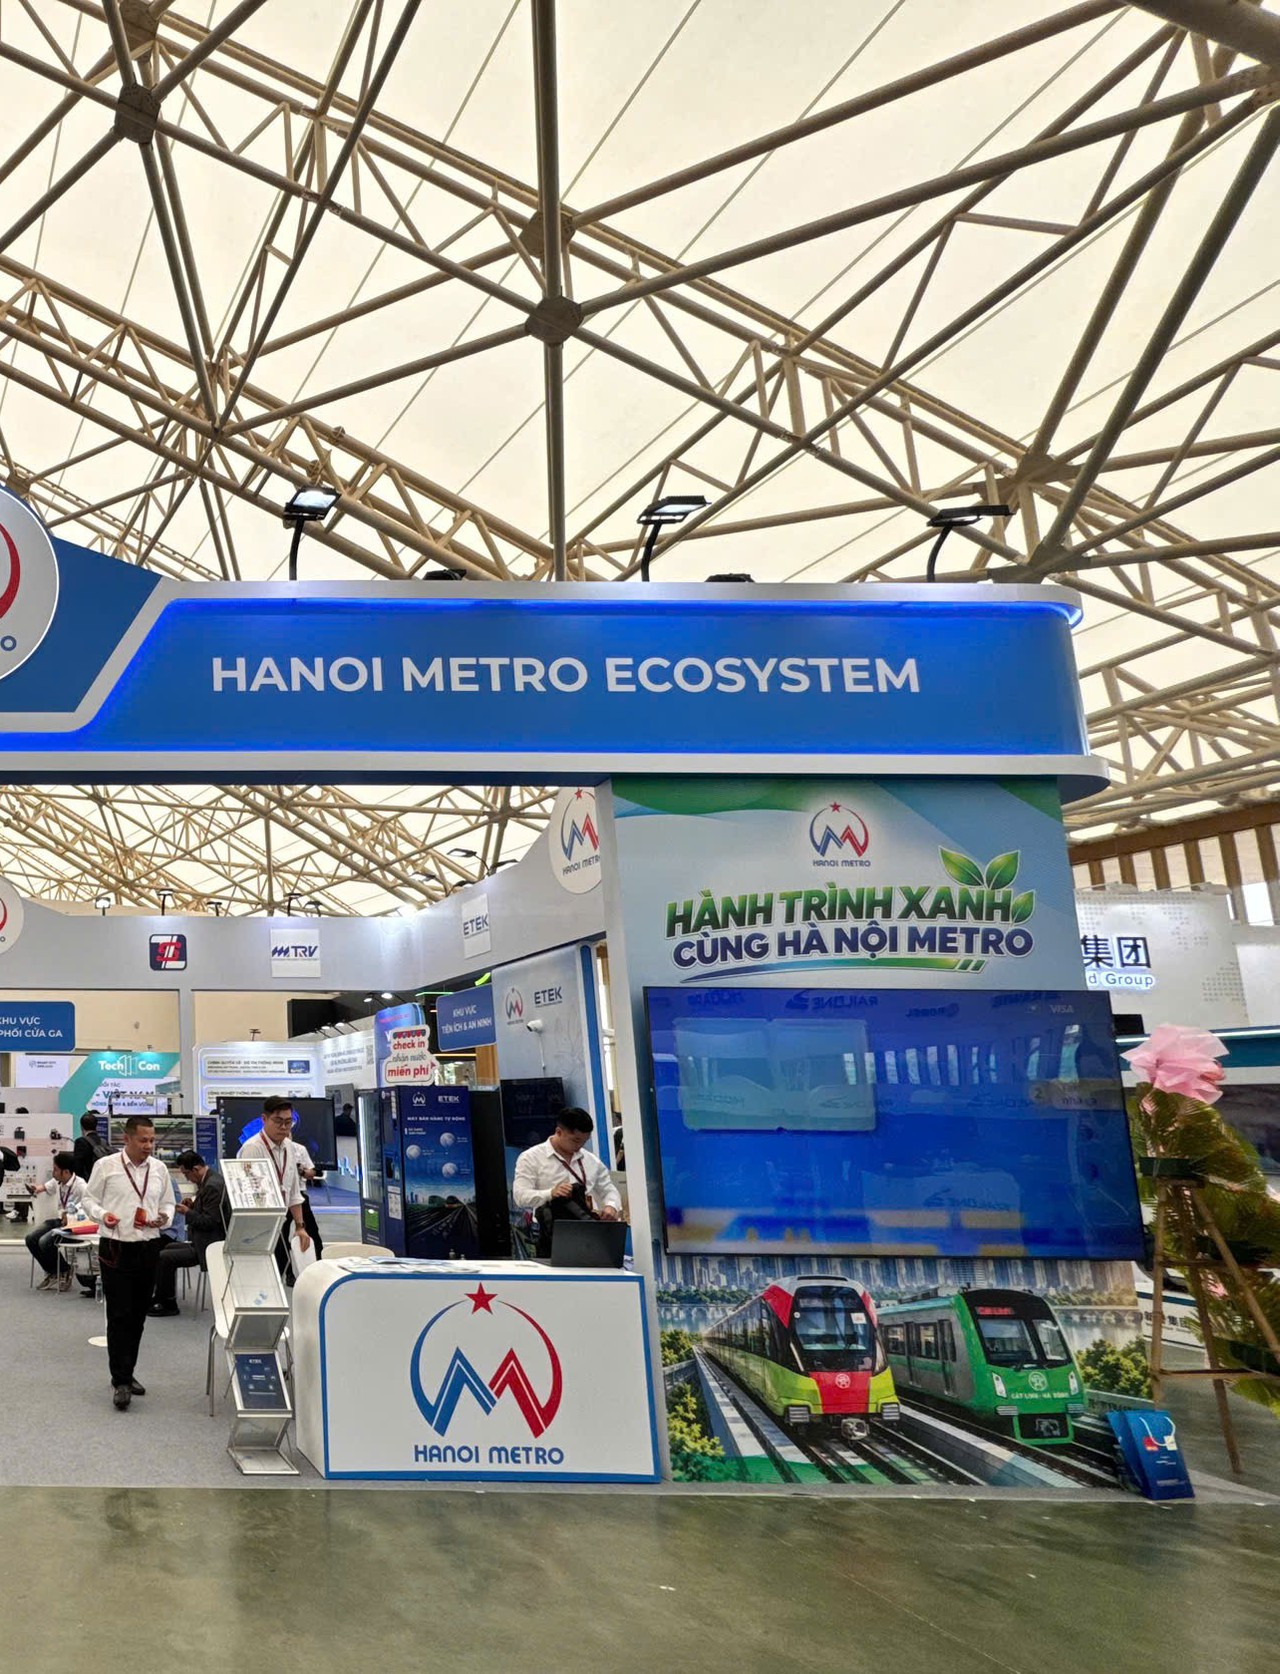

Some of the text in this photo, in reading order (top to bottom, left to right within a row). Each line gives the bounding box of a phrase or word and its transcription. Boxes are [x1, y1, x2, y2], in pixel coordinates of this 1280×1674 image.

[211, 656, 921, 694] HANOI METRO ECOSYSTEM
[562, 862, 581, 876] HANOI
[812, 859, 871, 867] HANOI METRO
[666, 881, 1014, 938] HÀNH TRÌNH XANH
[463, 914, 489, 935] ETEK
[672, 920, 1034, 969] CÙNG HÀ NỘI METRO
[1080, 934, 1151, 968] 集团
[1105, 973, 1154, 987] Group
[534, 986, 563, 1005] ETEK
[19, 1016, 41, 1027] VỰC
[24, 1026, 46, 1038] CỬA
[48, 1030, 63, 1038] GA
[393, 1039, 426, 1051] check in
[98, 1060, 160, 1071] Tech Con
[387, 1063, 429, 1078] miễn phí
[414, 1445, 564, 1465] HANOI METRO
